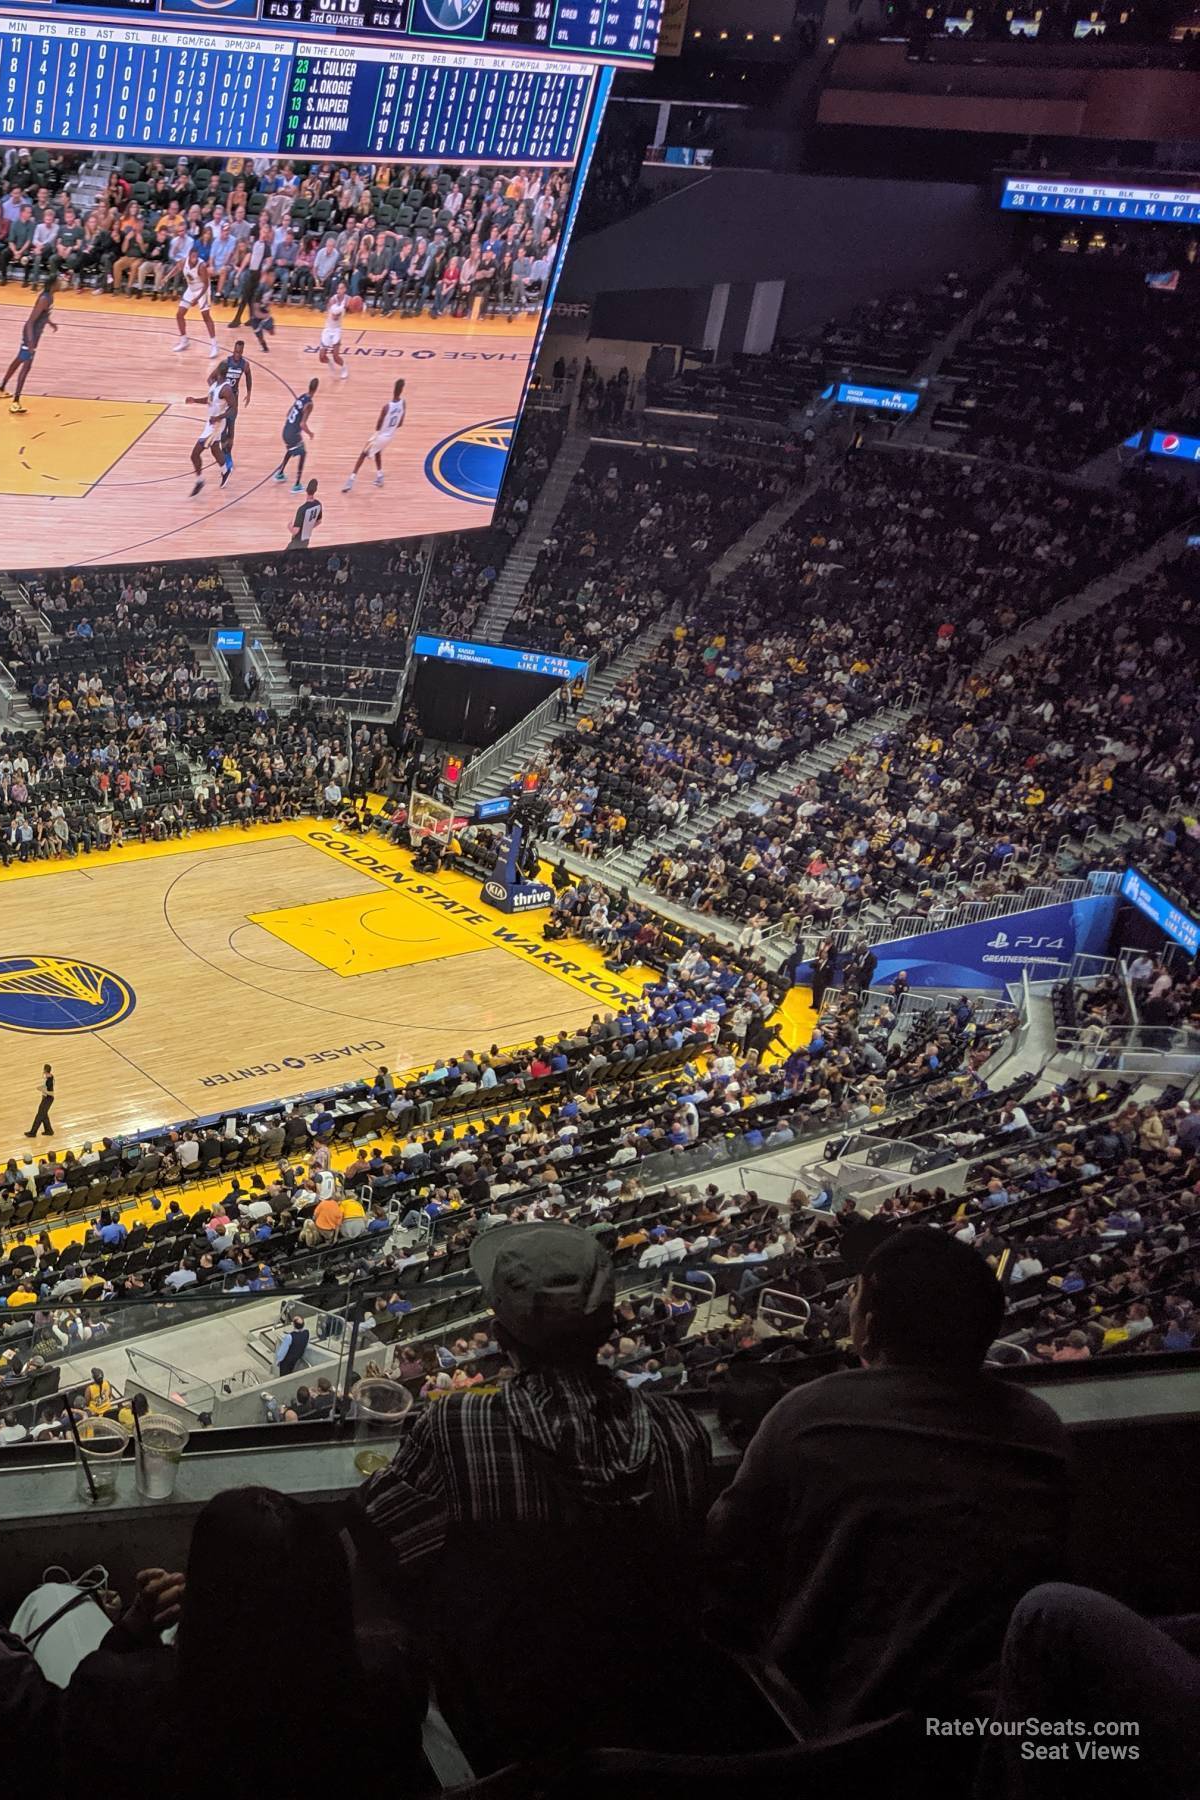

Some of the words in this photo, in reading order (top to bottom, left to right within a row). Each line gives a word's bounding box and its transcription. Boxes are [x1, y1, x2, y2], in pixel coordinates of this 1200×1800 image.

[271, 4, 288, 16] FLS
[294, 4, 301, 18] 2
[310, 12, 324, 22] 3rd
[326, 13, 364, 26] QUARTER
[374, 14, 389, 25] FLS
[394, 14, 400, 28] 4
[8, 22, 27, 31] MIN
[39, 24, 56, 34] PTS
[68, 27, 86, 37] REB
[96, 29, 114, 39] AST
[125, 32, 140, 41] STL
[151, 34, 168, 43] BLK
[176, 35, 216, 48] FGM/FGA
[224, 38, 262, 51] 3PM/3PA
[274, 43, 285, 52] PF
[296, 60, 309, 74] 23
[313, 60, 321, 75] J.
[323, 61, 357, 77] CULVER
[293, 78, 306, 92] 20
[310, 79, 318, 93] J.
[320, 80, 353, 95] OKOGIE
[292, 97, 301, 110] 13
[306, 98, 315, 112] S.
[317, 98, 348, 114] NAPIER
[288, 116, 298, 129] 10
[303, 116, 312, 130] J.
[313, 117, 349, 132] LAYMAN
[286, 134, 294, 147] 11
[300, 134, 309, 148] N.
[311, 135, 331, 148] REID
[1041, 196, 1048, 207] 7
[1063, 198, 1076, 209] 24
[1145, 205, 1155, 215] 14
[1172, 206, 1183, 216] 17
[522, 654, 540, 662] GET
[545, 658, 569, 667] CARE
[518, 662, 538, 671] LIKE
[552, 667, 570, 676] PRO
[489, 885, 504, 898] KIA
[513, 890, 551, 906] thrive
[308, 832, 411, 884] GOLDEN
[407, 884, 491, 926] STATE
[492, 926, 641, 1006] WARRIOR
[1015, 936, 1064, 948] PS4
[304, 1040, 385, 1064] CHASE
[199, 1063, 281, 1087] CENTER
